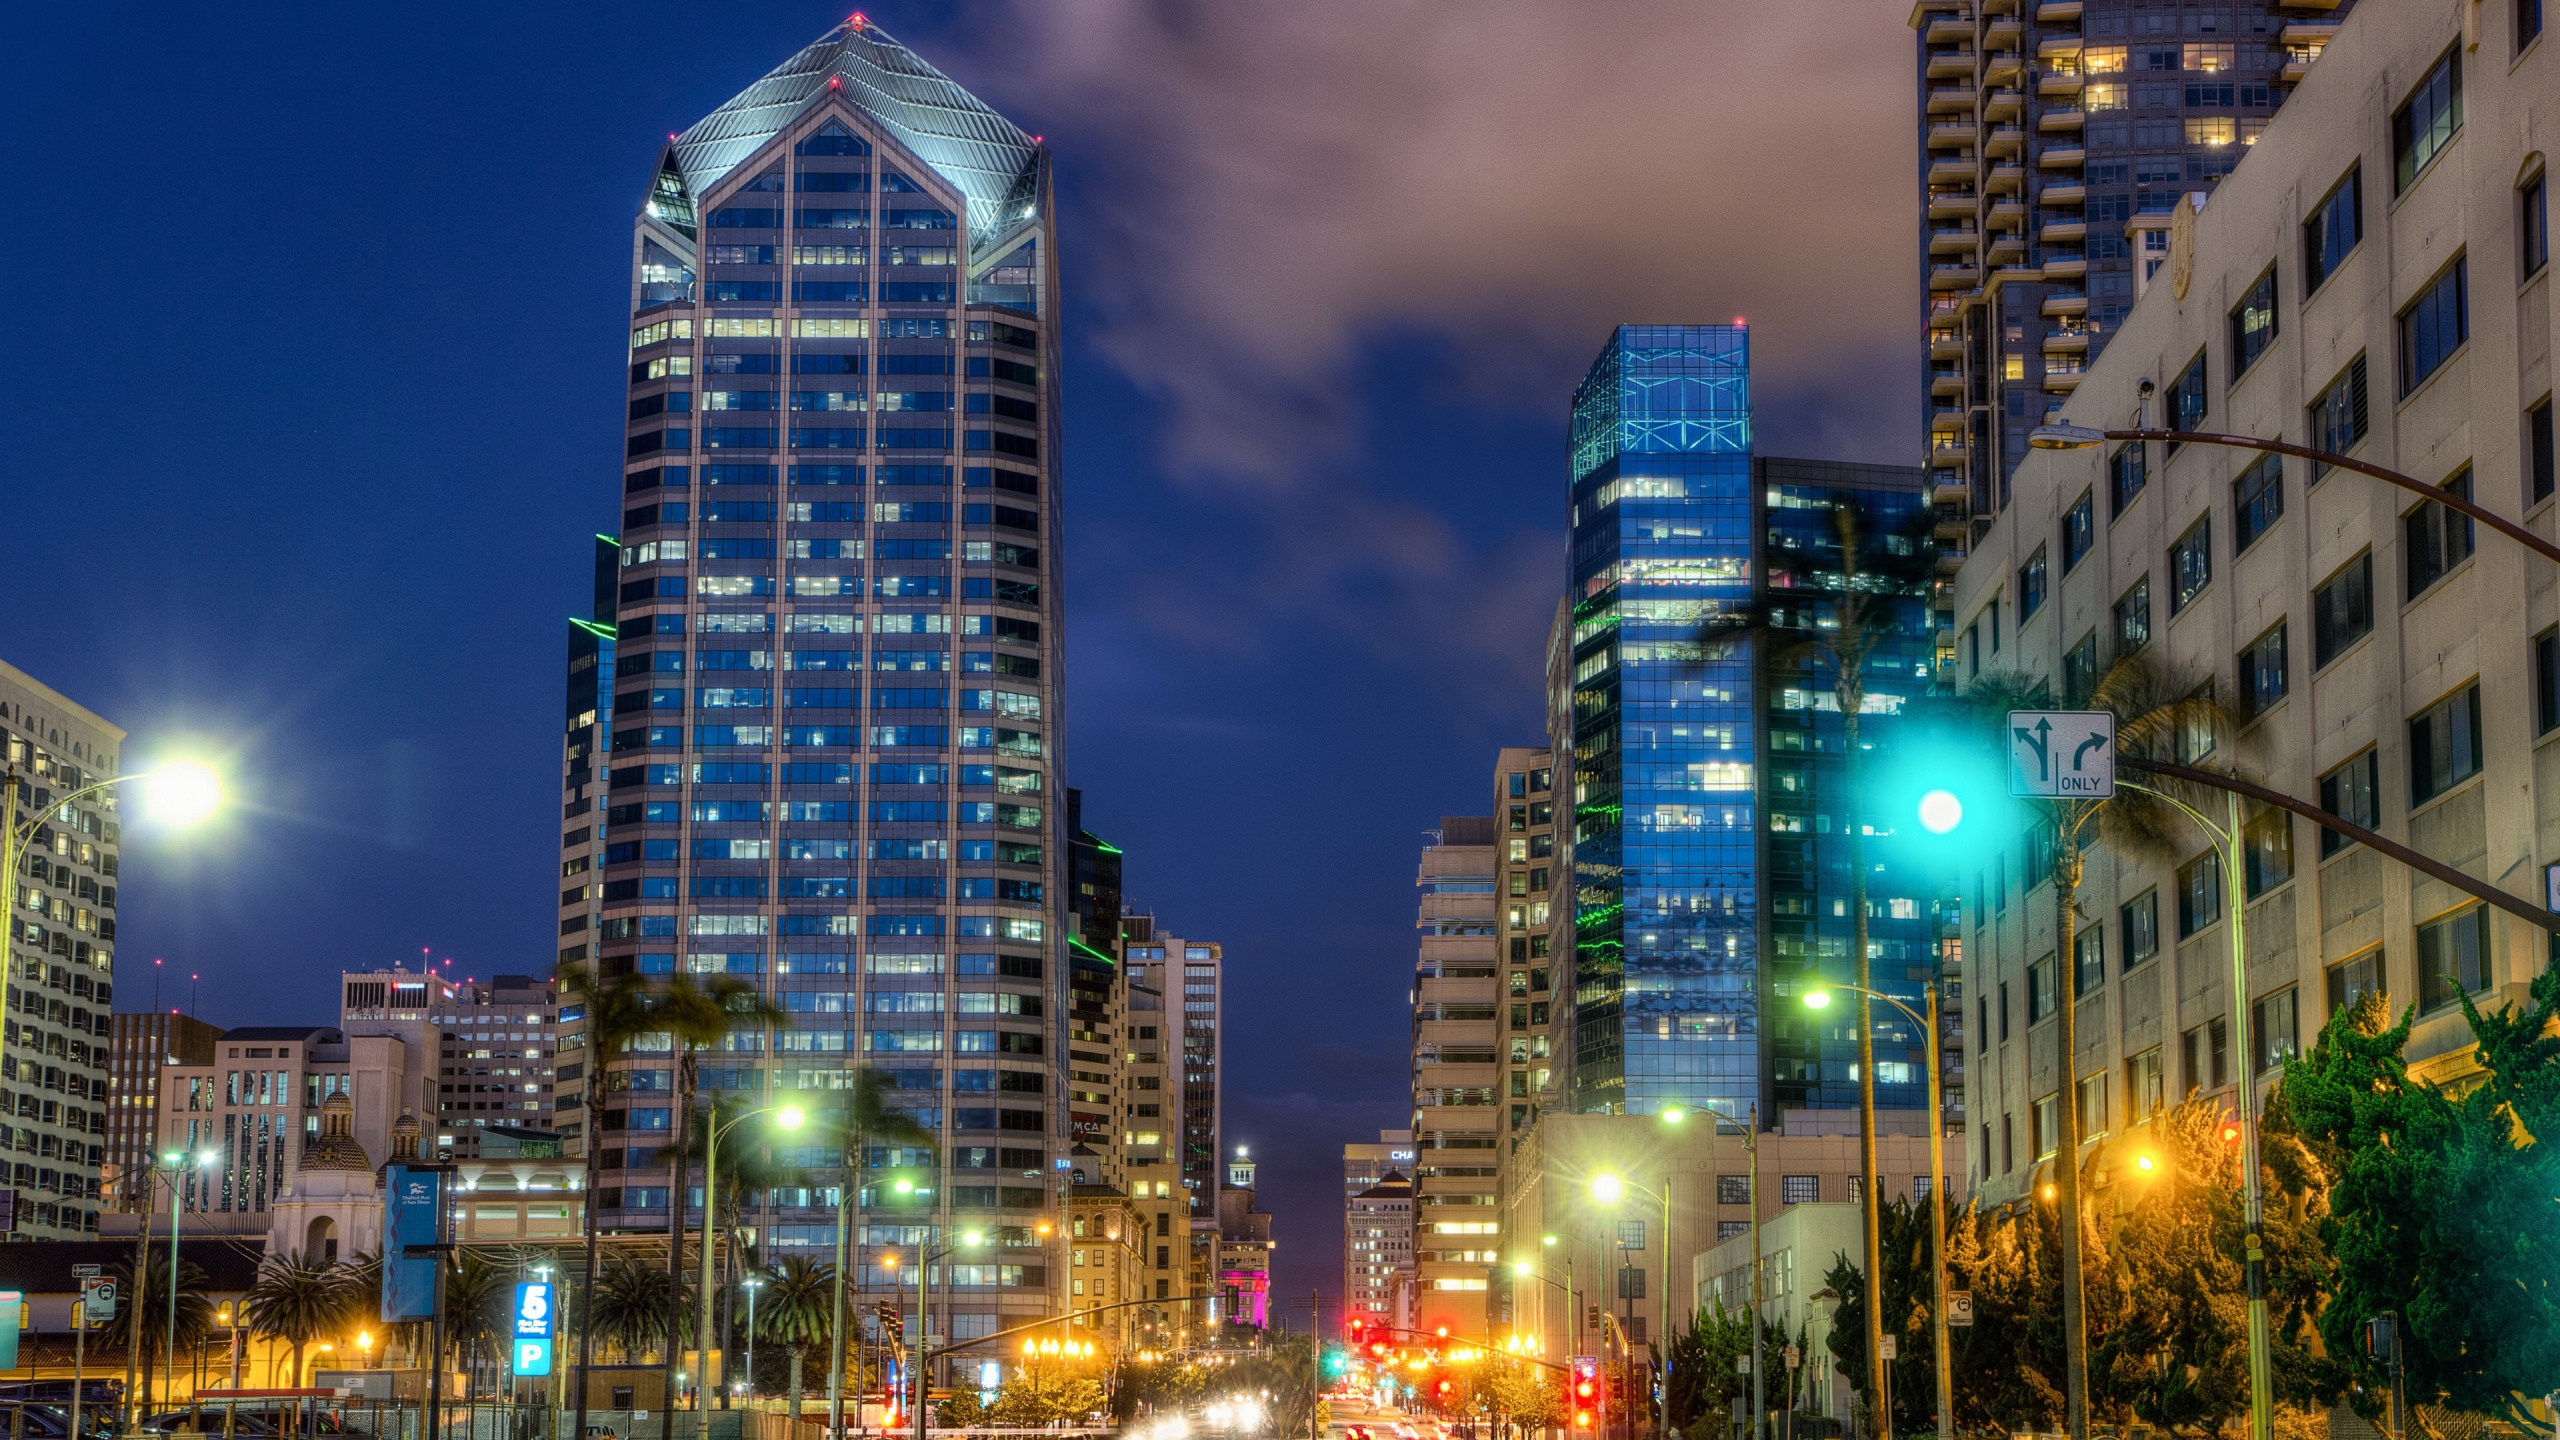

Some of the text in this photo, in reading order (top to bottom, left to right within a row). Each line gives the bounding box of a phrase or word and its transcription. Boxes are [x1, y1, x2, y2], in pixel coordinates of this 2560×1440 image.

[2062, 777, 2100, 790] ONLY
[1070, 1122, 1099, 1131] MCA
[521, 1285, 547, 1320] 5
[521, 1344, 542, 1368] P
